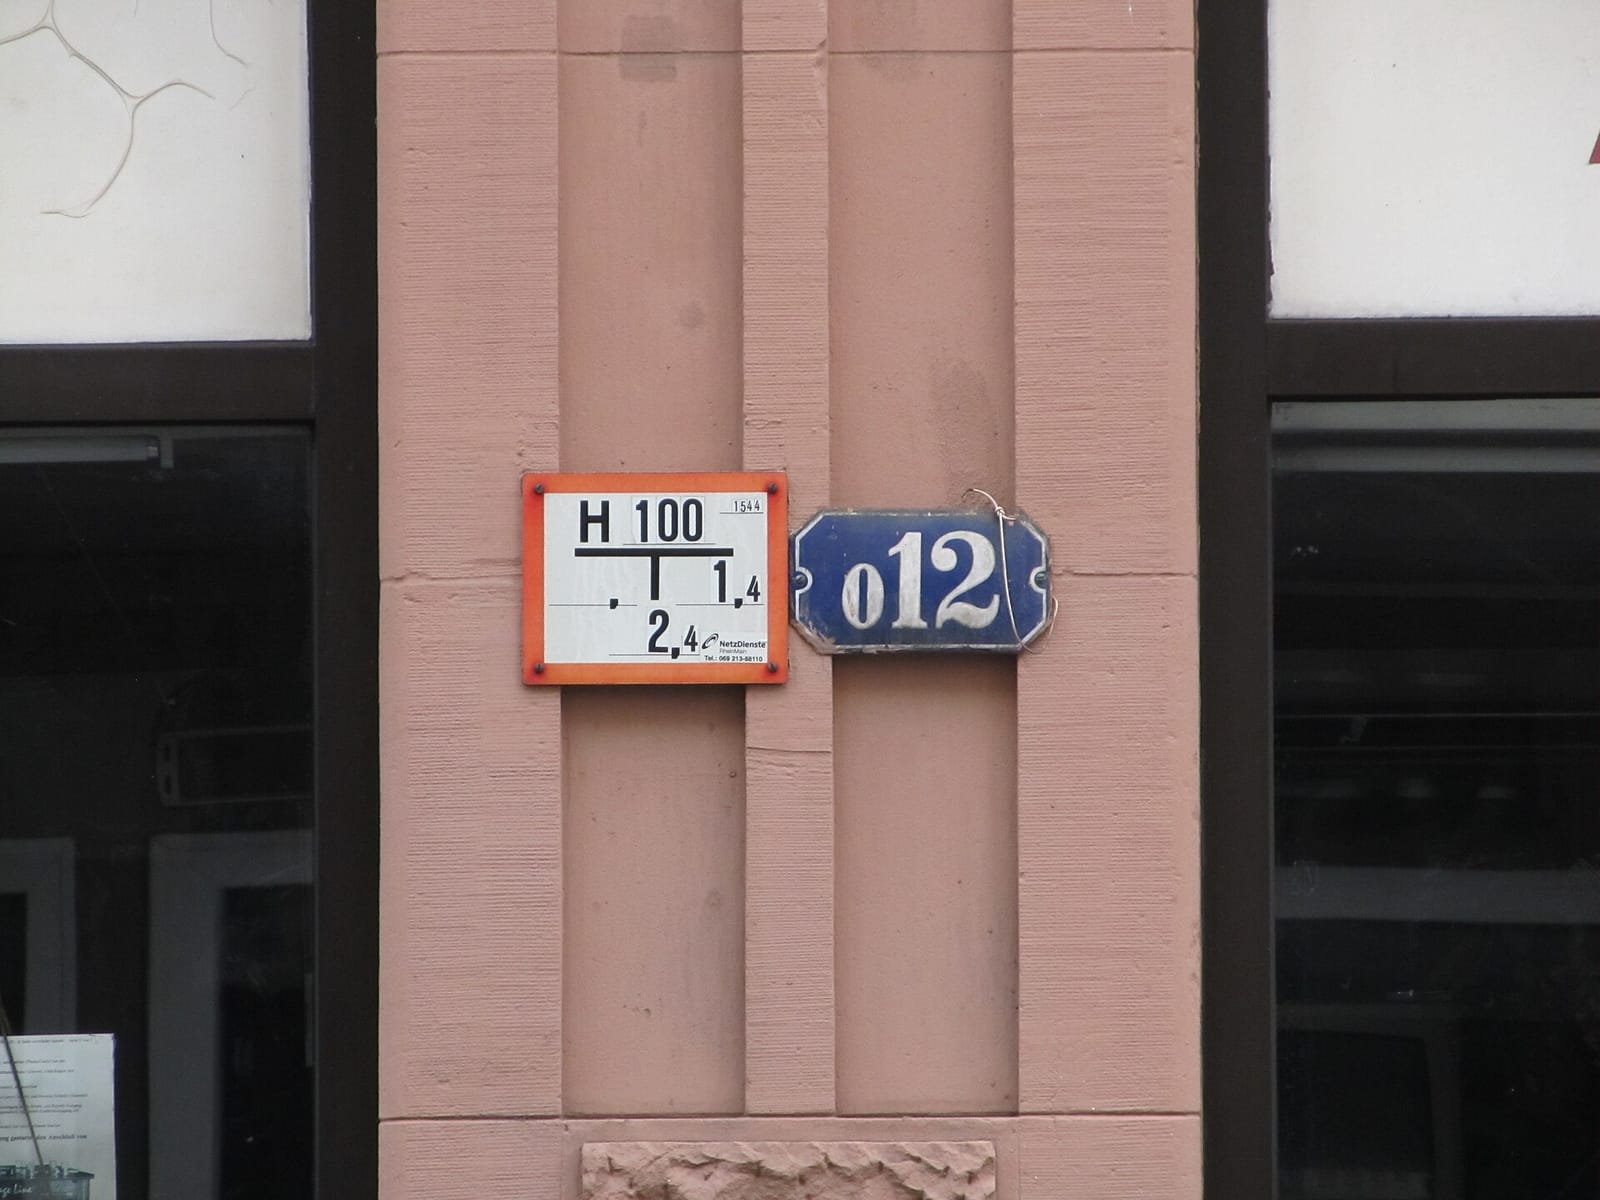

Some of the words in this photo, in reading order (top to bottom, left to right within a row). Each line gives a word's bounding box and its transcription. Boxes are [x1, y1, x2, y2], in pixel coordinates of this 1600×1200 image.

[733, 499, 760, 512] 1544
[579, 500, 610, 543] H
[635, 498, 703, 542] 100
[648, 609, 698, 659] 2,4
[719, 640, 766, 648] NetzDienste
